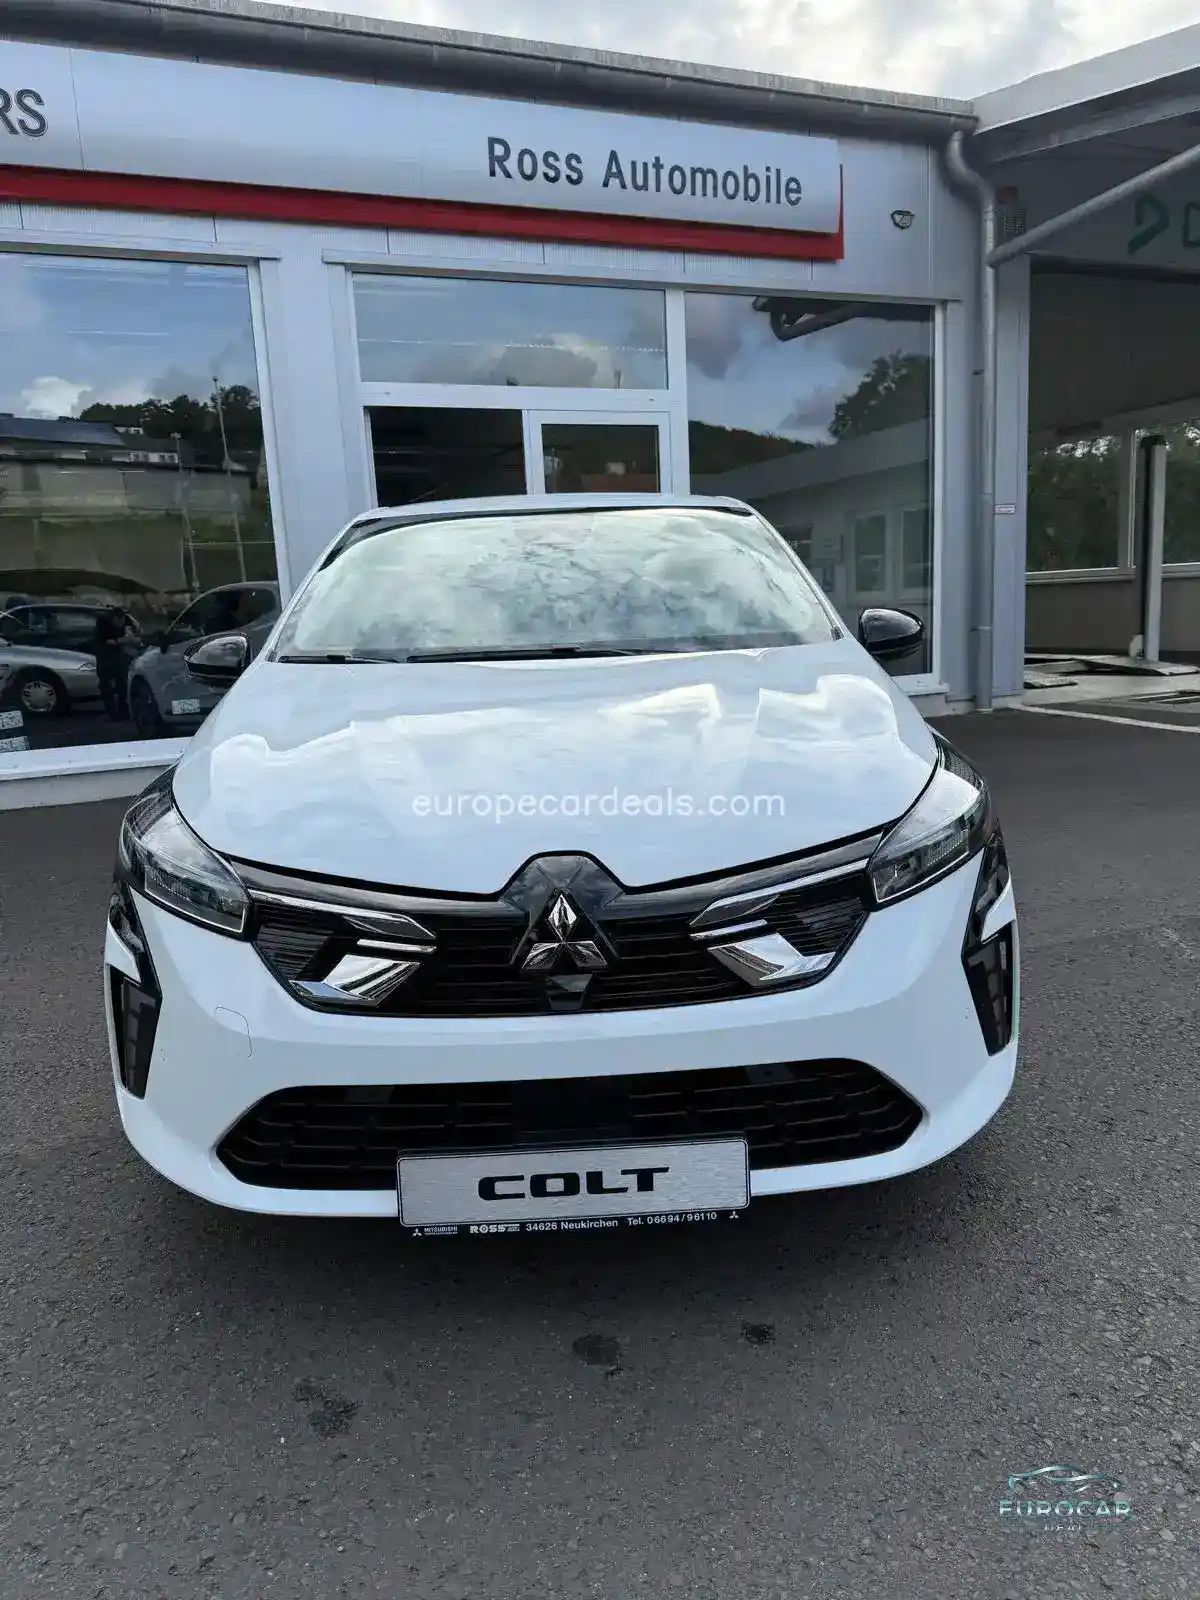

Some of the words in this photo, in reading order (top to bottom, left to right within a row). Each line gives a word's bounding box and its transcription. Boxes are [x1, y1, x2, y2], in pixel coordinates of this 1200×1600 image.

[487, 136, 584, 186] Ross
[601, 149, 802, 206] Automobile
[477, 1166, 670, 1201] COLT
[469, 1223, 506, 1234] ROSS
[525, 1221, 558, 1232] 34626
[560, 1218, 619, 1231] Neukirchen
[627, 1216, 645, 1226] Tel.
